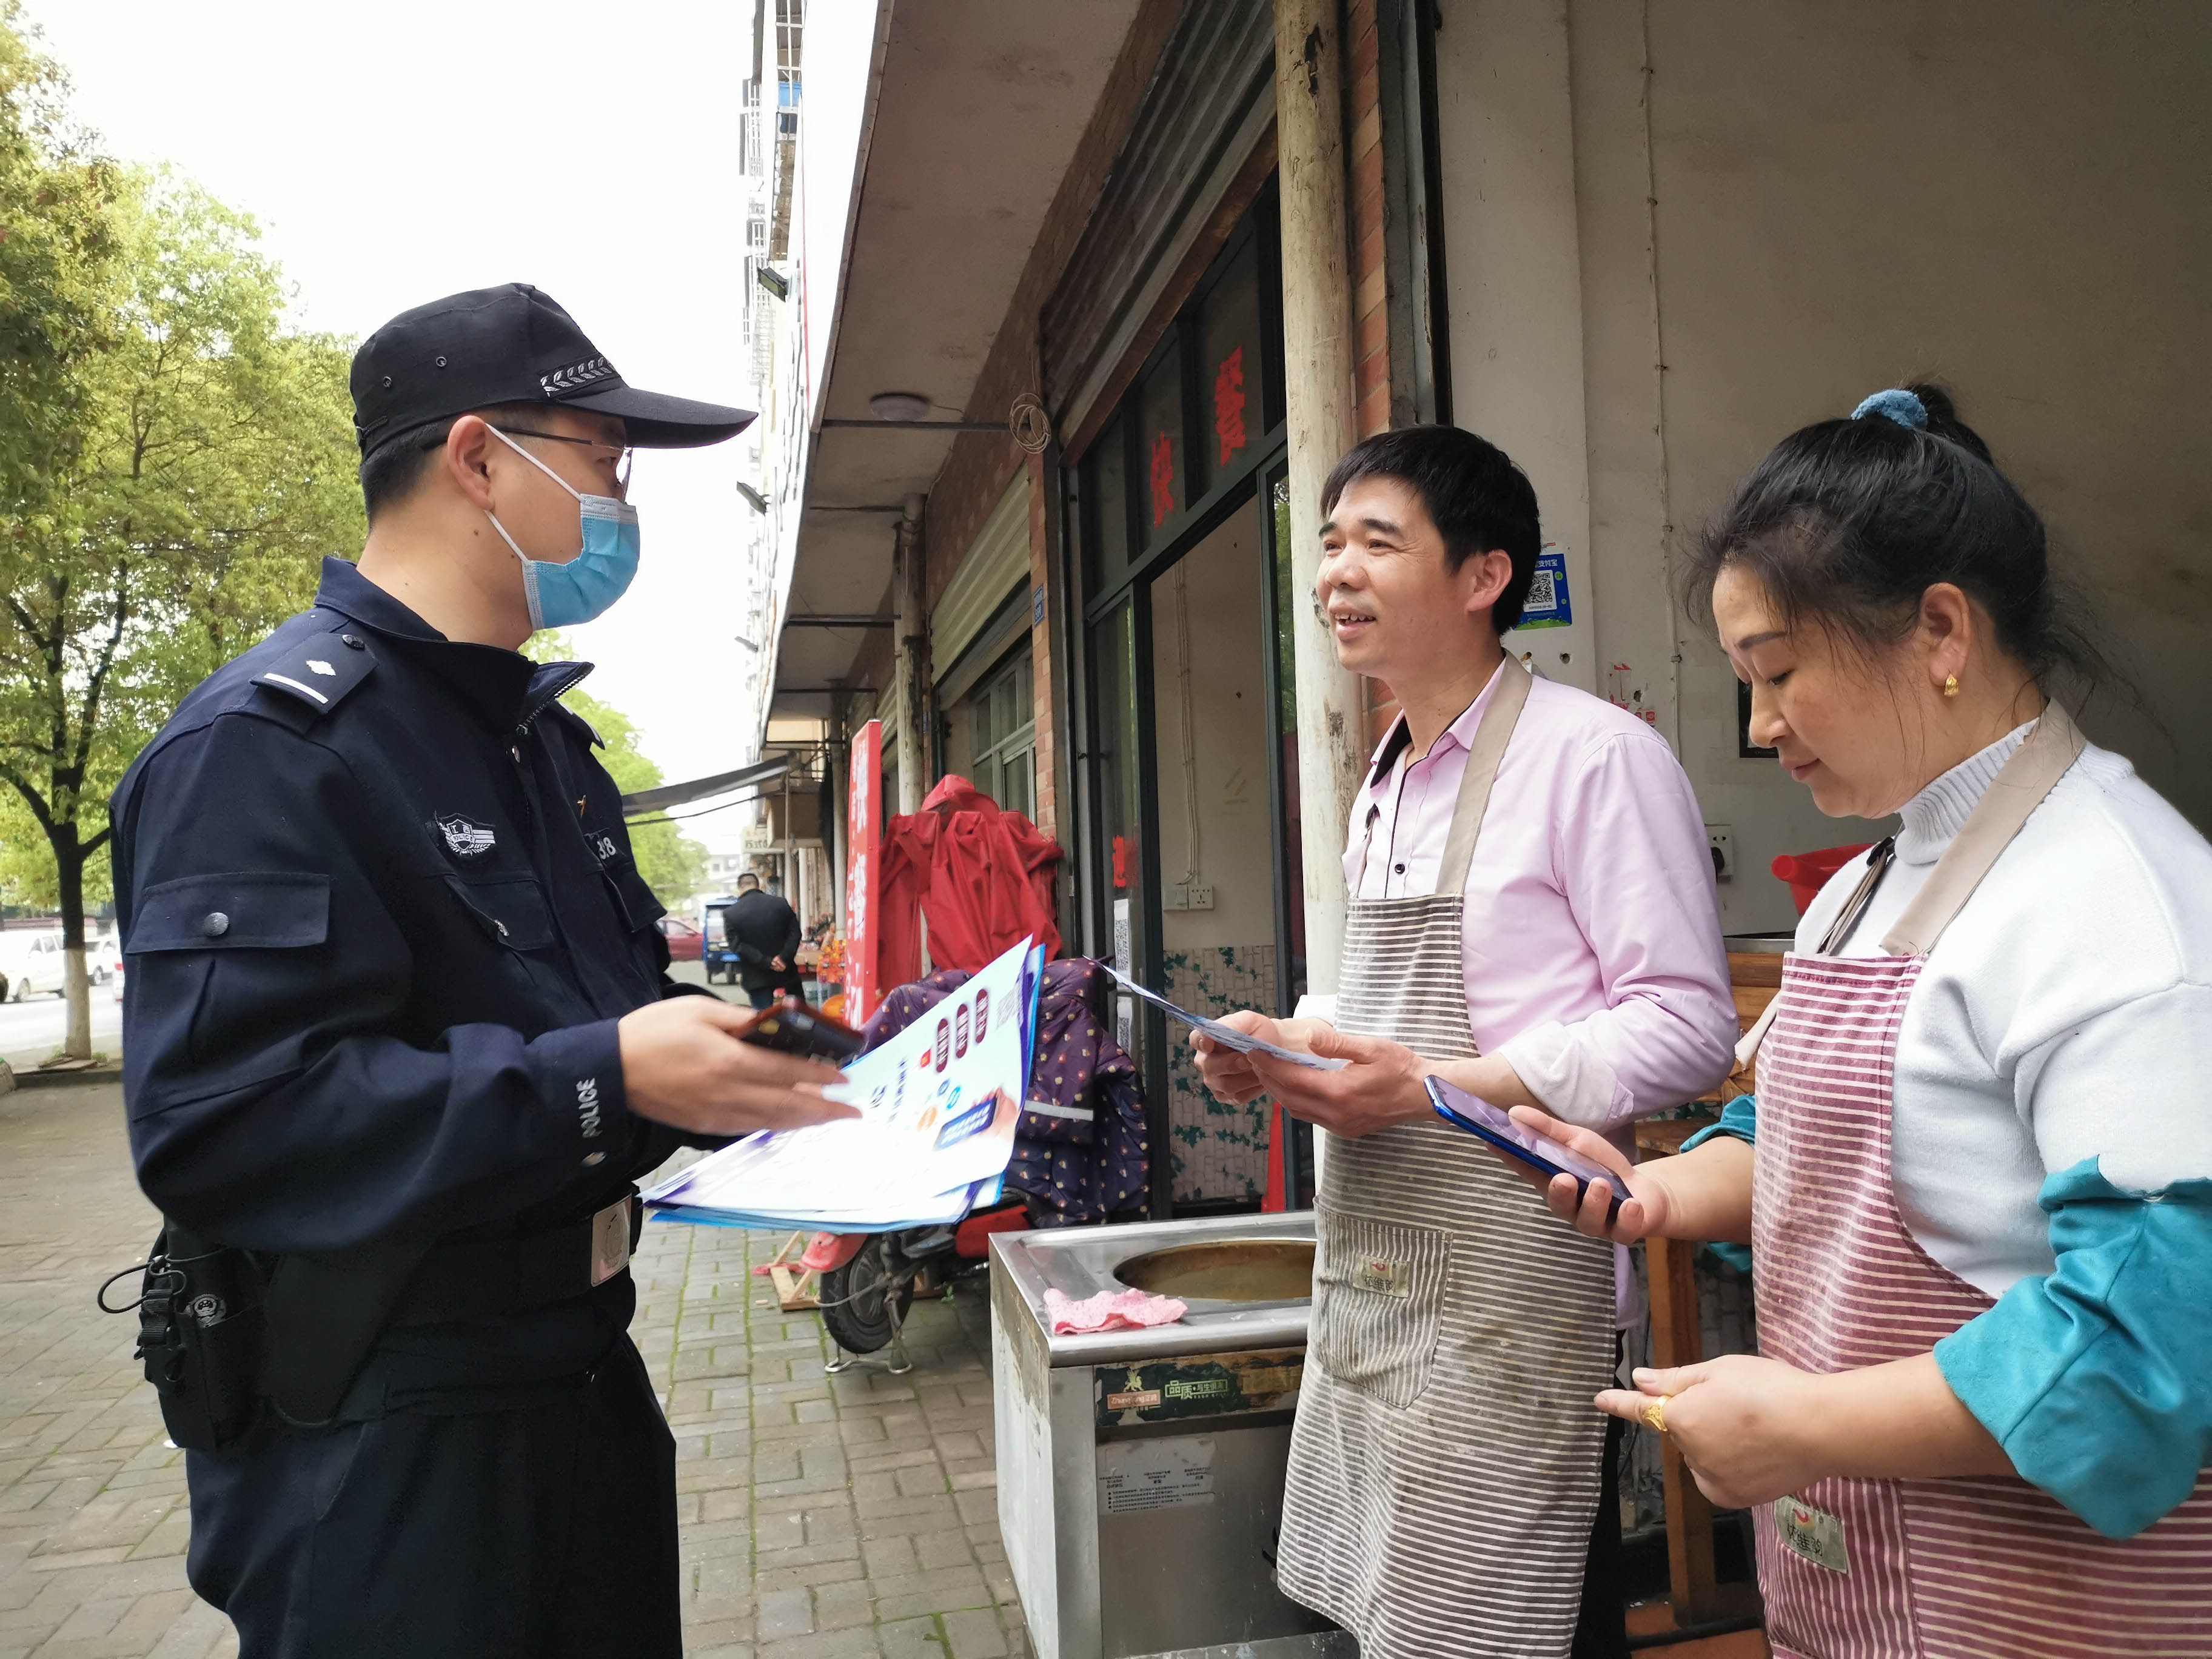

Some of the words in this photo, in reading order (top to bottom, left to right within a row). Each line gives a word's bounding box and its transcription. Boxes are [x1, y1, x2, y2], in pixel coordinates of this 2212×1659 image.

[1535, 559, 1558, 568] 支付宝
[576, 1078, 603, 1138] POLICE
